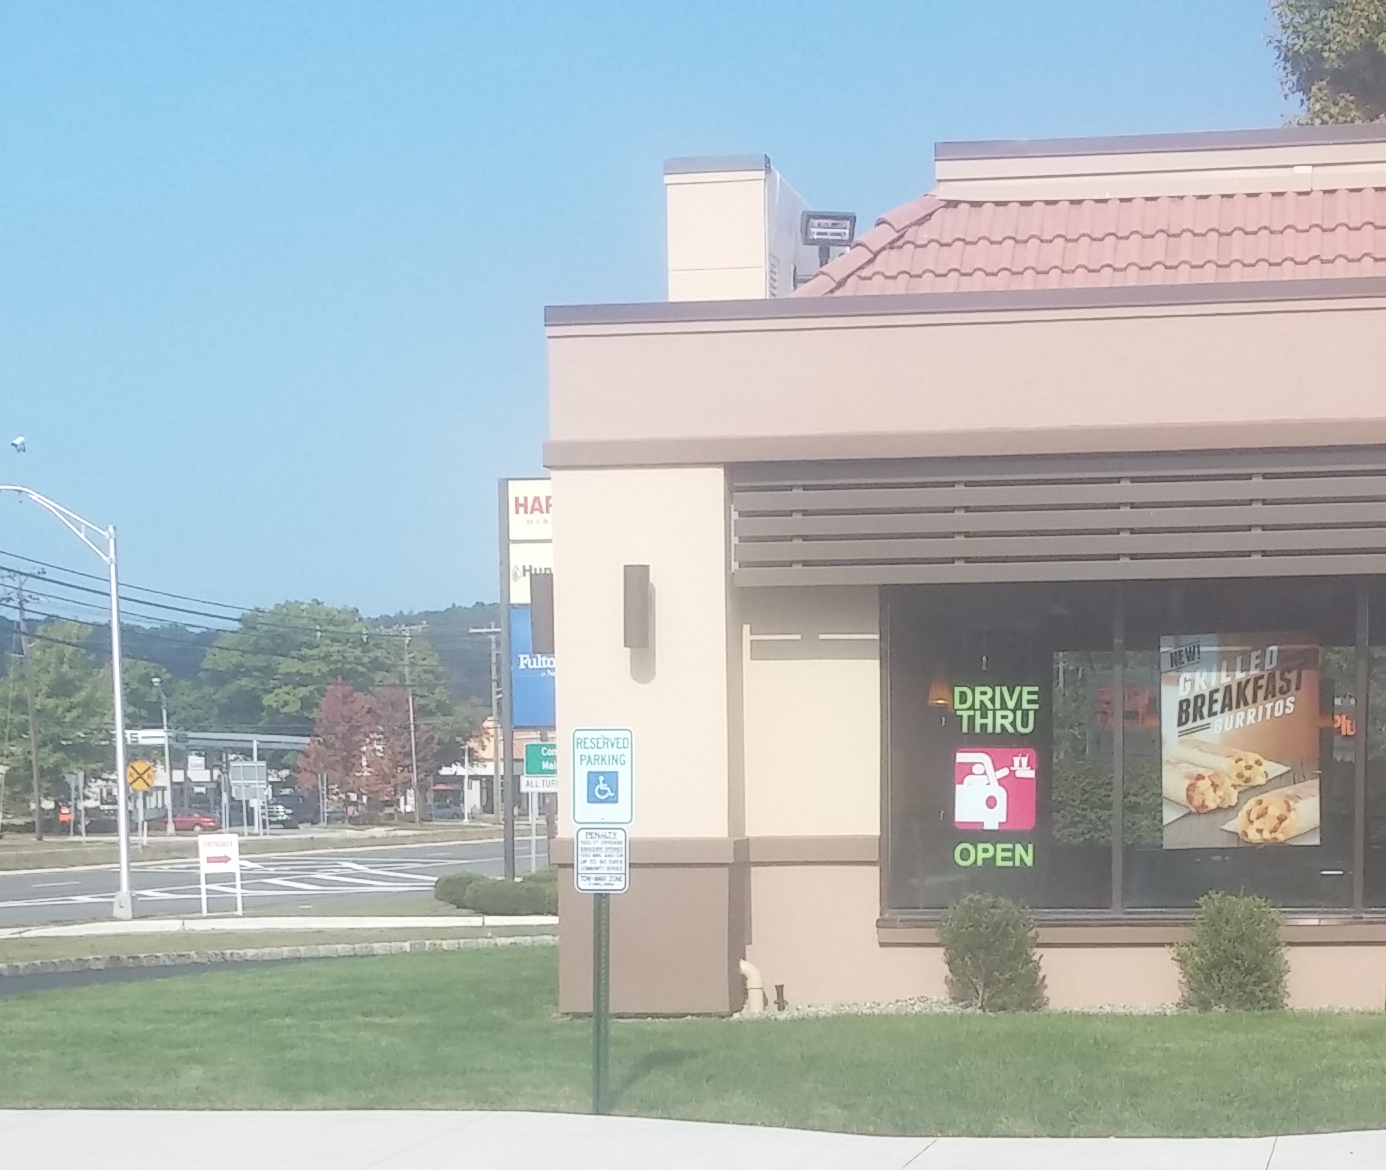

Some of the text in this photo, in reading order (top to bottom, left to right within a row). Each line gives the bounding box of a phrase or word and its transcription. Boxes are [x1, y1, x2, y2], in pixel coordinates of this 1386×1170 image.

[1170, 643, 1201, 668] NEW!
[1178, 645, 1279, 697] GRILLED
[953, 685, 1040, 710] DRIVE
[1177, 663, 1303, 728] BREAKFAST
[955, 709, 1035, 734] THRU
[1214, 696, 1296, 735] BURRITOS
[576, 737, 629, 749] RESERVED
[579, 754, 626, 766] PARKING
[586, 831, 617, 839] PENALTY
[954, 842, 1034, 867] OPEN
